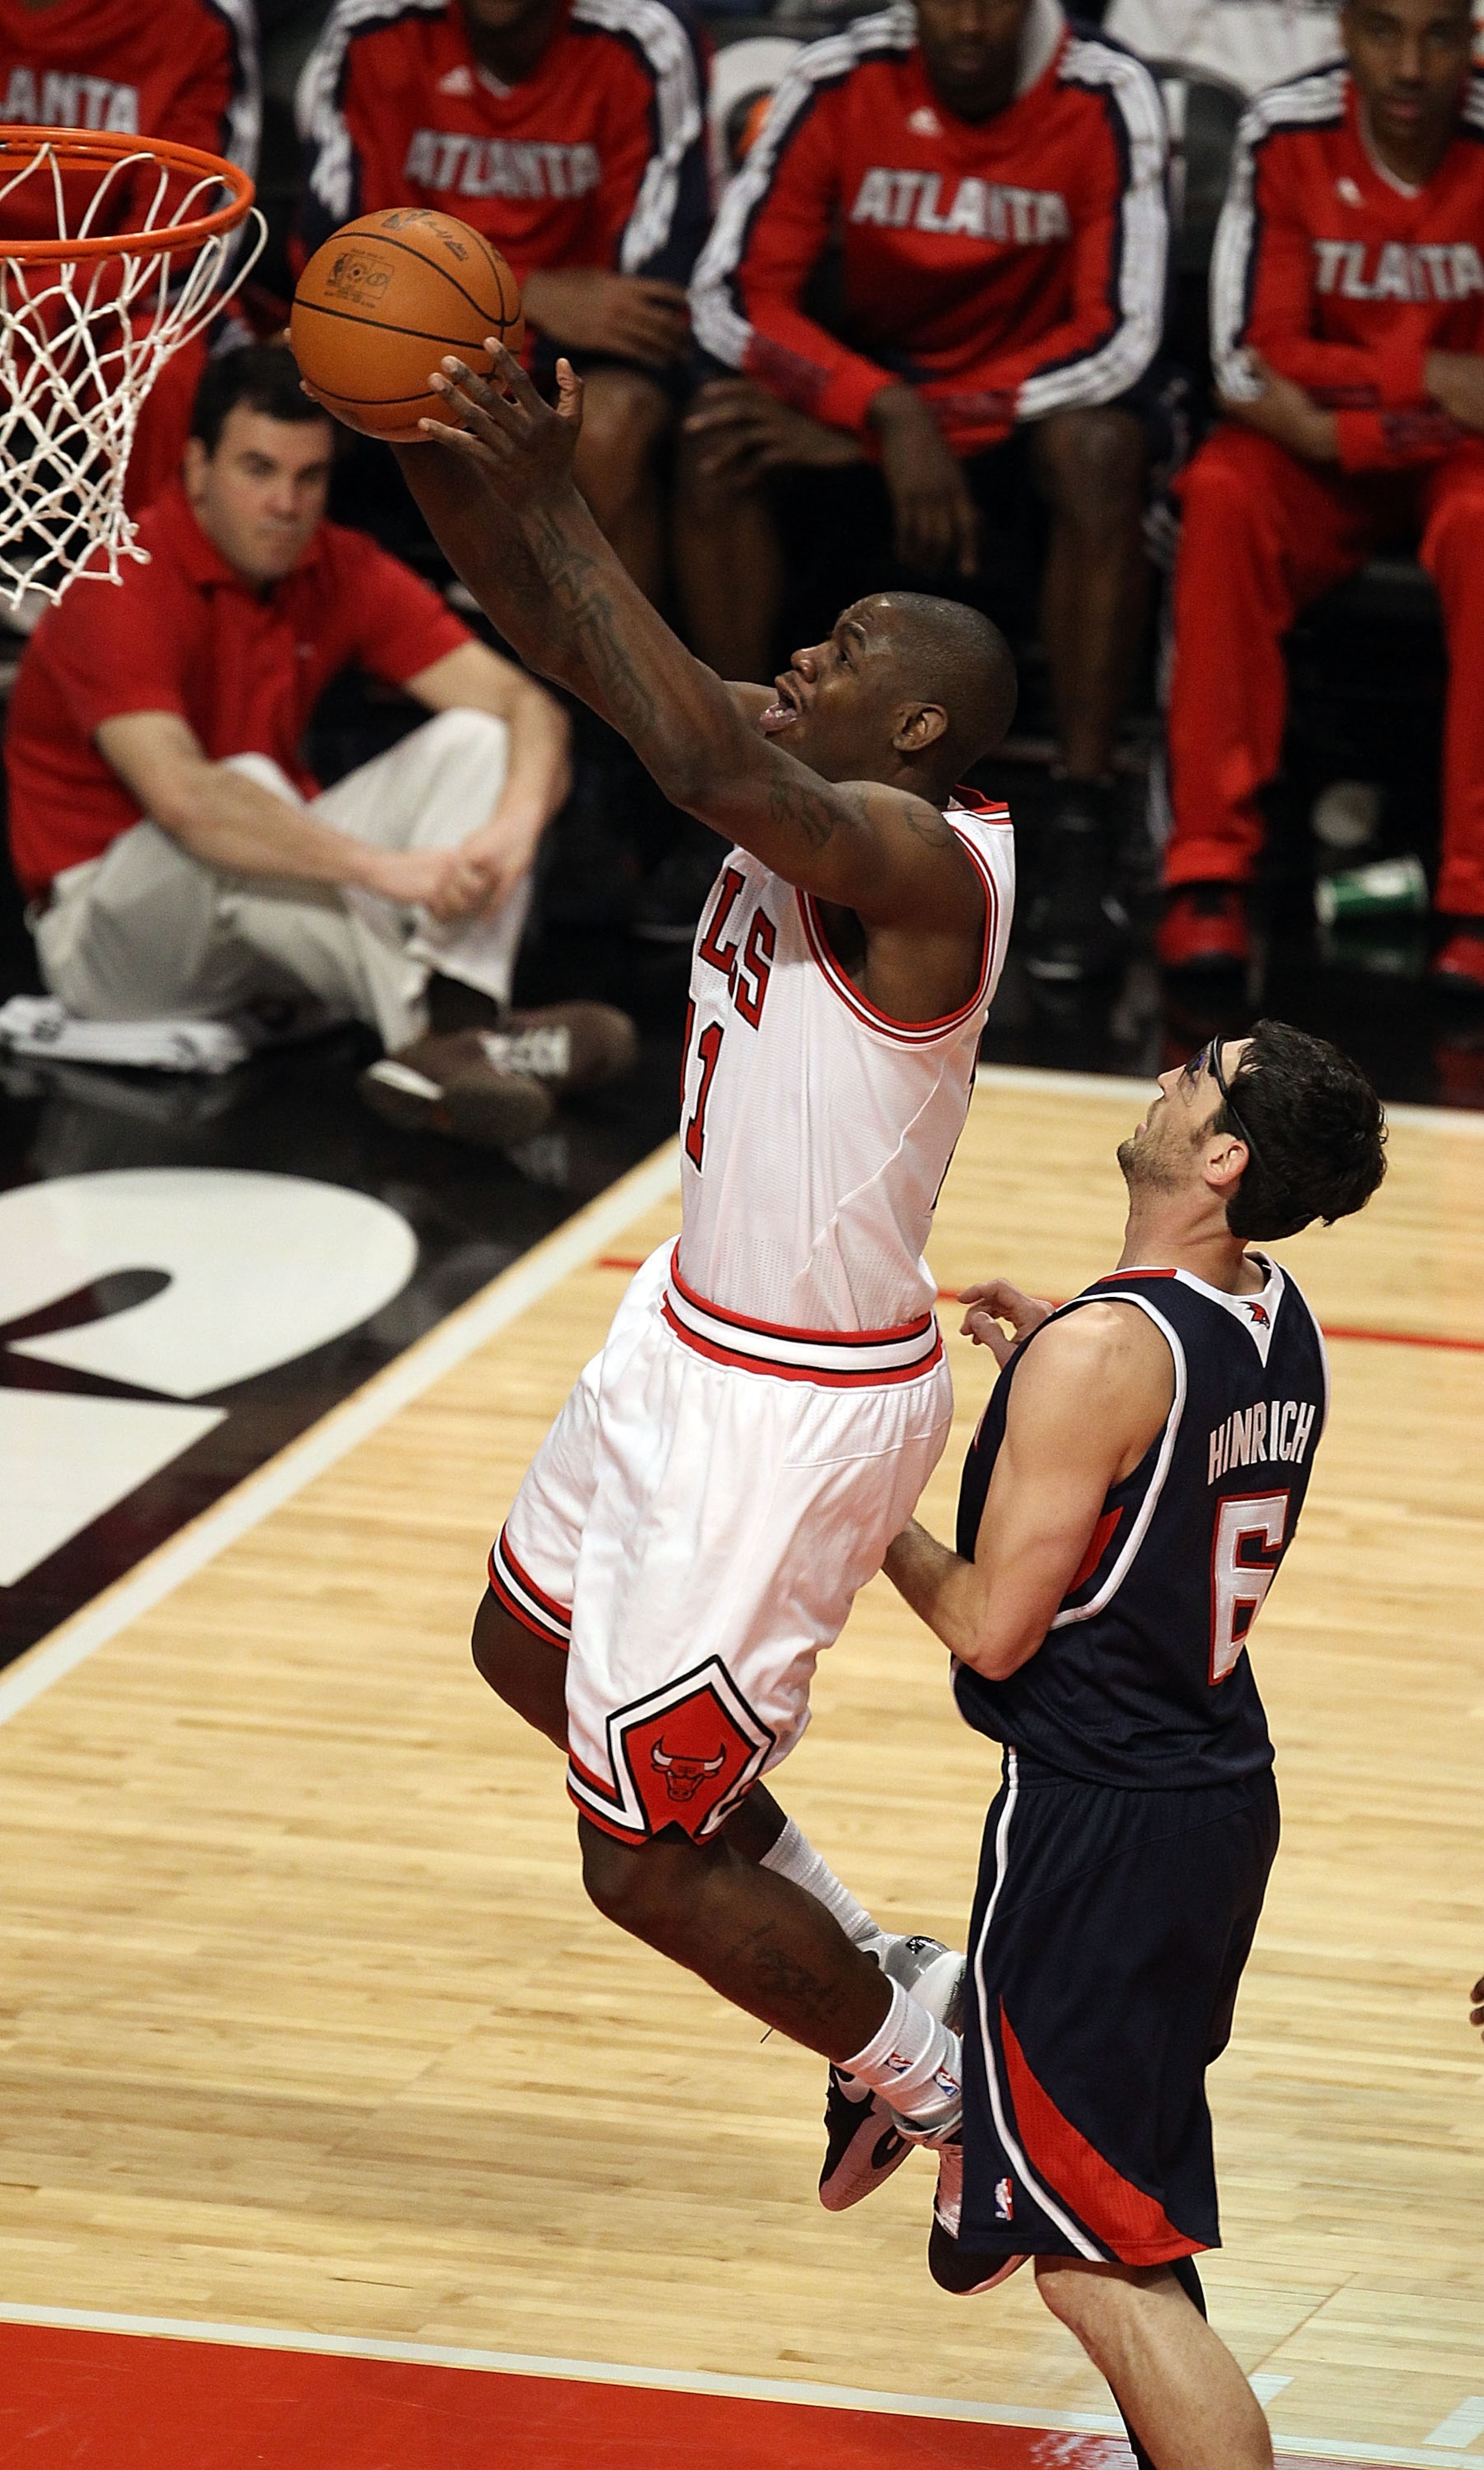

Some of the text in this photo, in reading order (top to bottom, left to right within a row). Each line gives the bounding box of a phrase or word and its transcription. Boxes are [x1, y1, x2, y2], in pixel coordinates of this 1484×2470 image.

[0, 65, 140, 135] ANTA
[1208, 1401, 1315, 1485] HINRICH
[1208, 1488, 1290, 1686] 6
